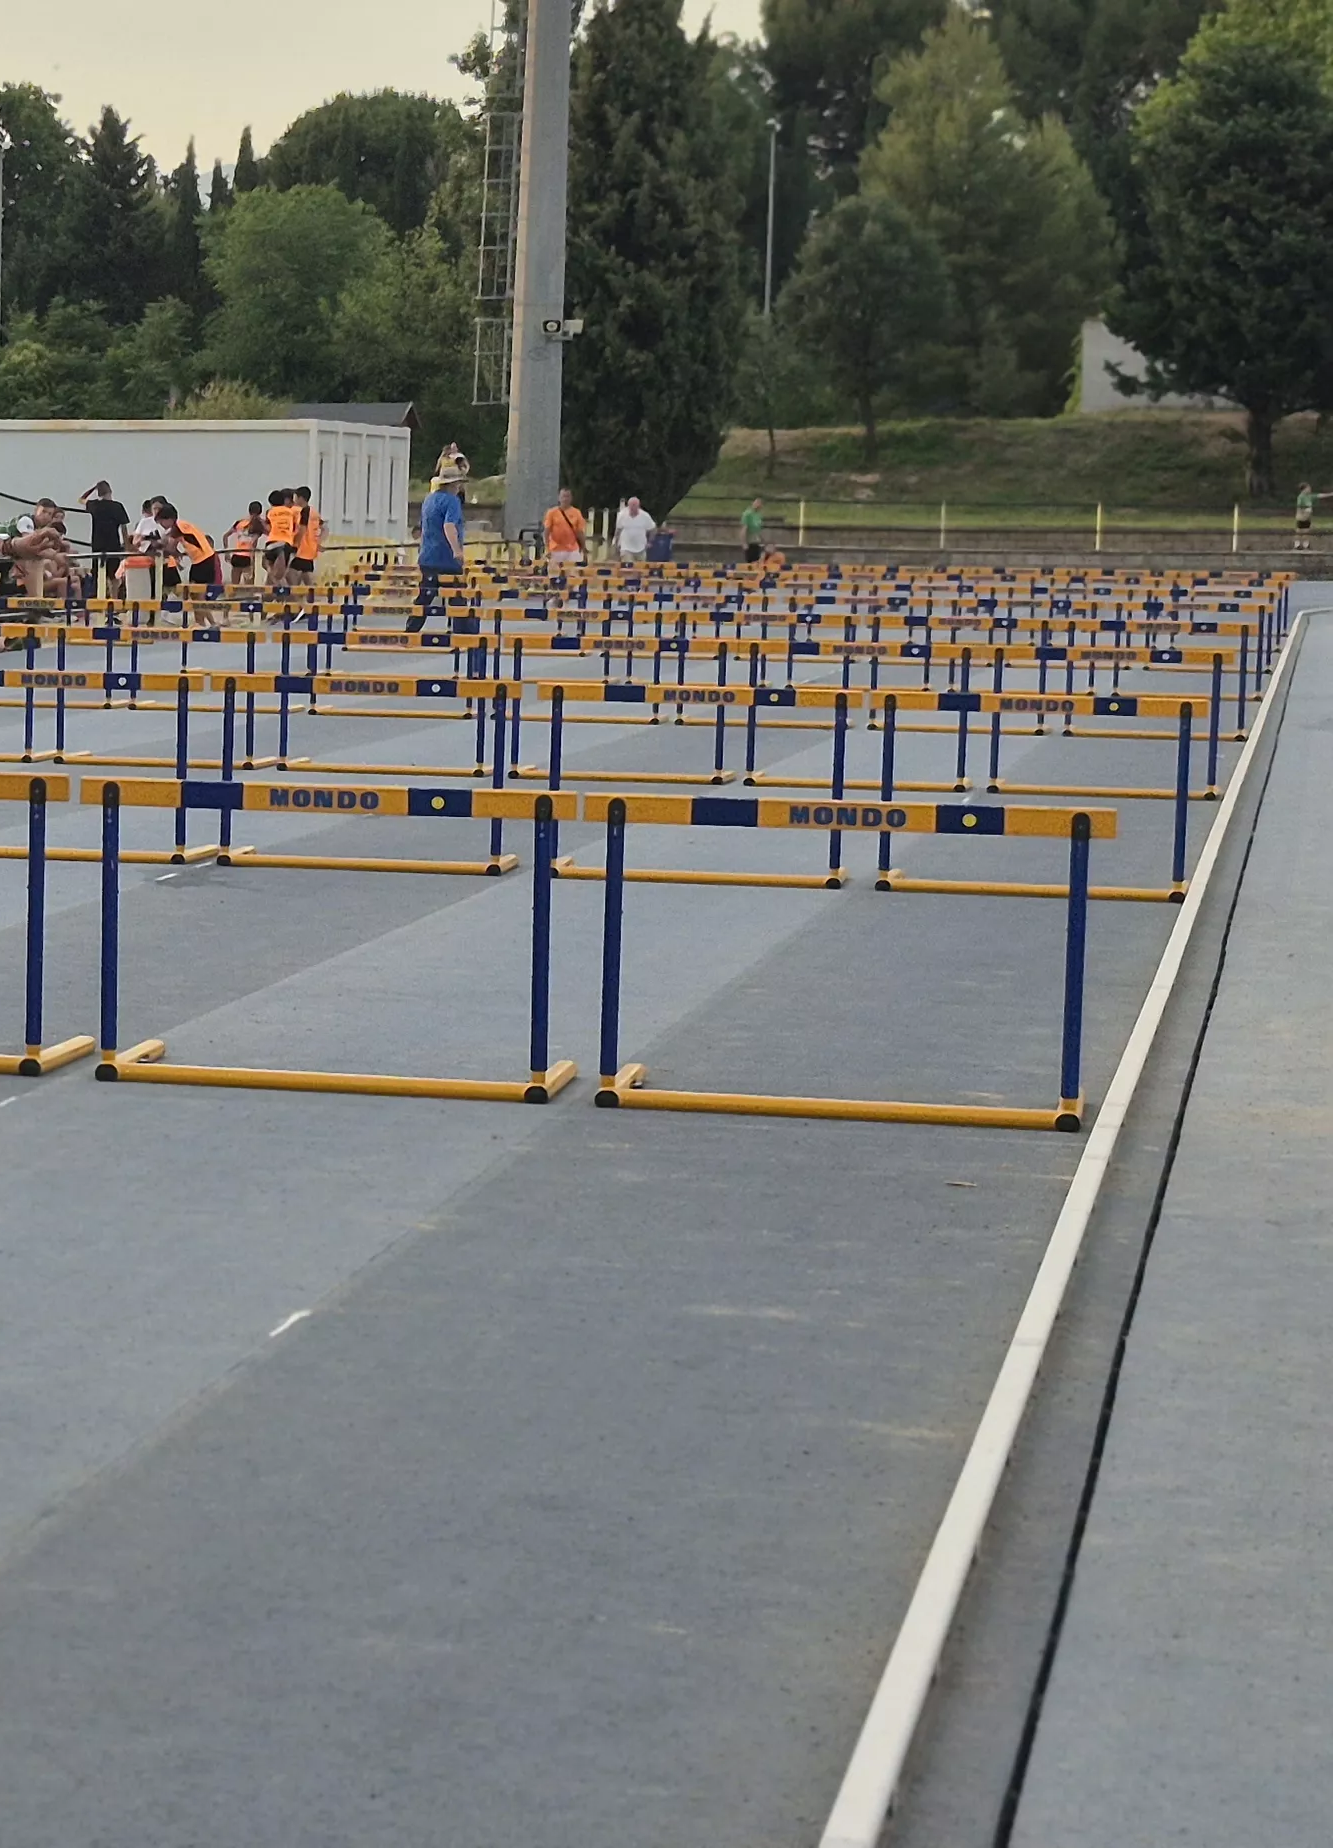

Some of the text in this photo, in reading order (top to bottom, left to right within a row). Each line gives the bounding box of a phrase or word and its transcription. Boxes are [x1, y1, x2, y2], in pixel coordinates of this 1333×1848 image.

[21, 673, 86, 687] MONDO
[329, 679, 400, 693] MONDO
[663, 689, 736, 703] MONDO
[999, 698, 1075, 712] MONDO
[269, 787, 381, 809] MONDO
[789, 804, 907, 828] MONDO
